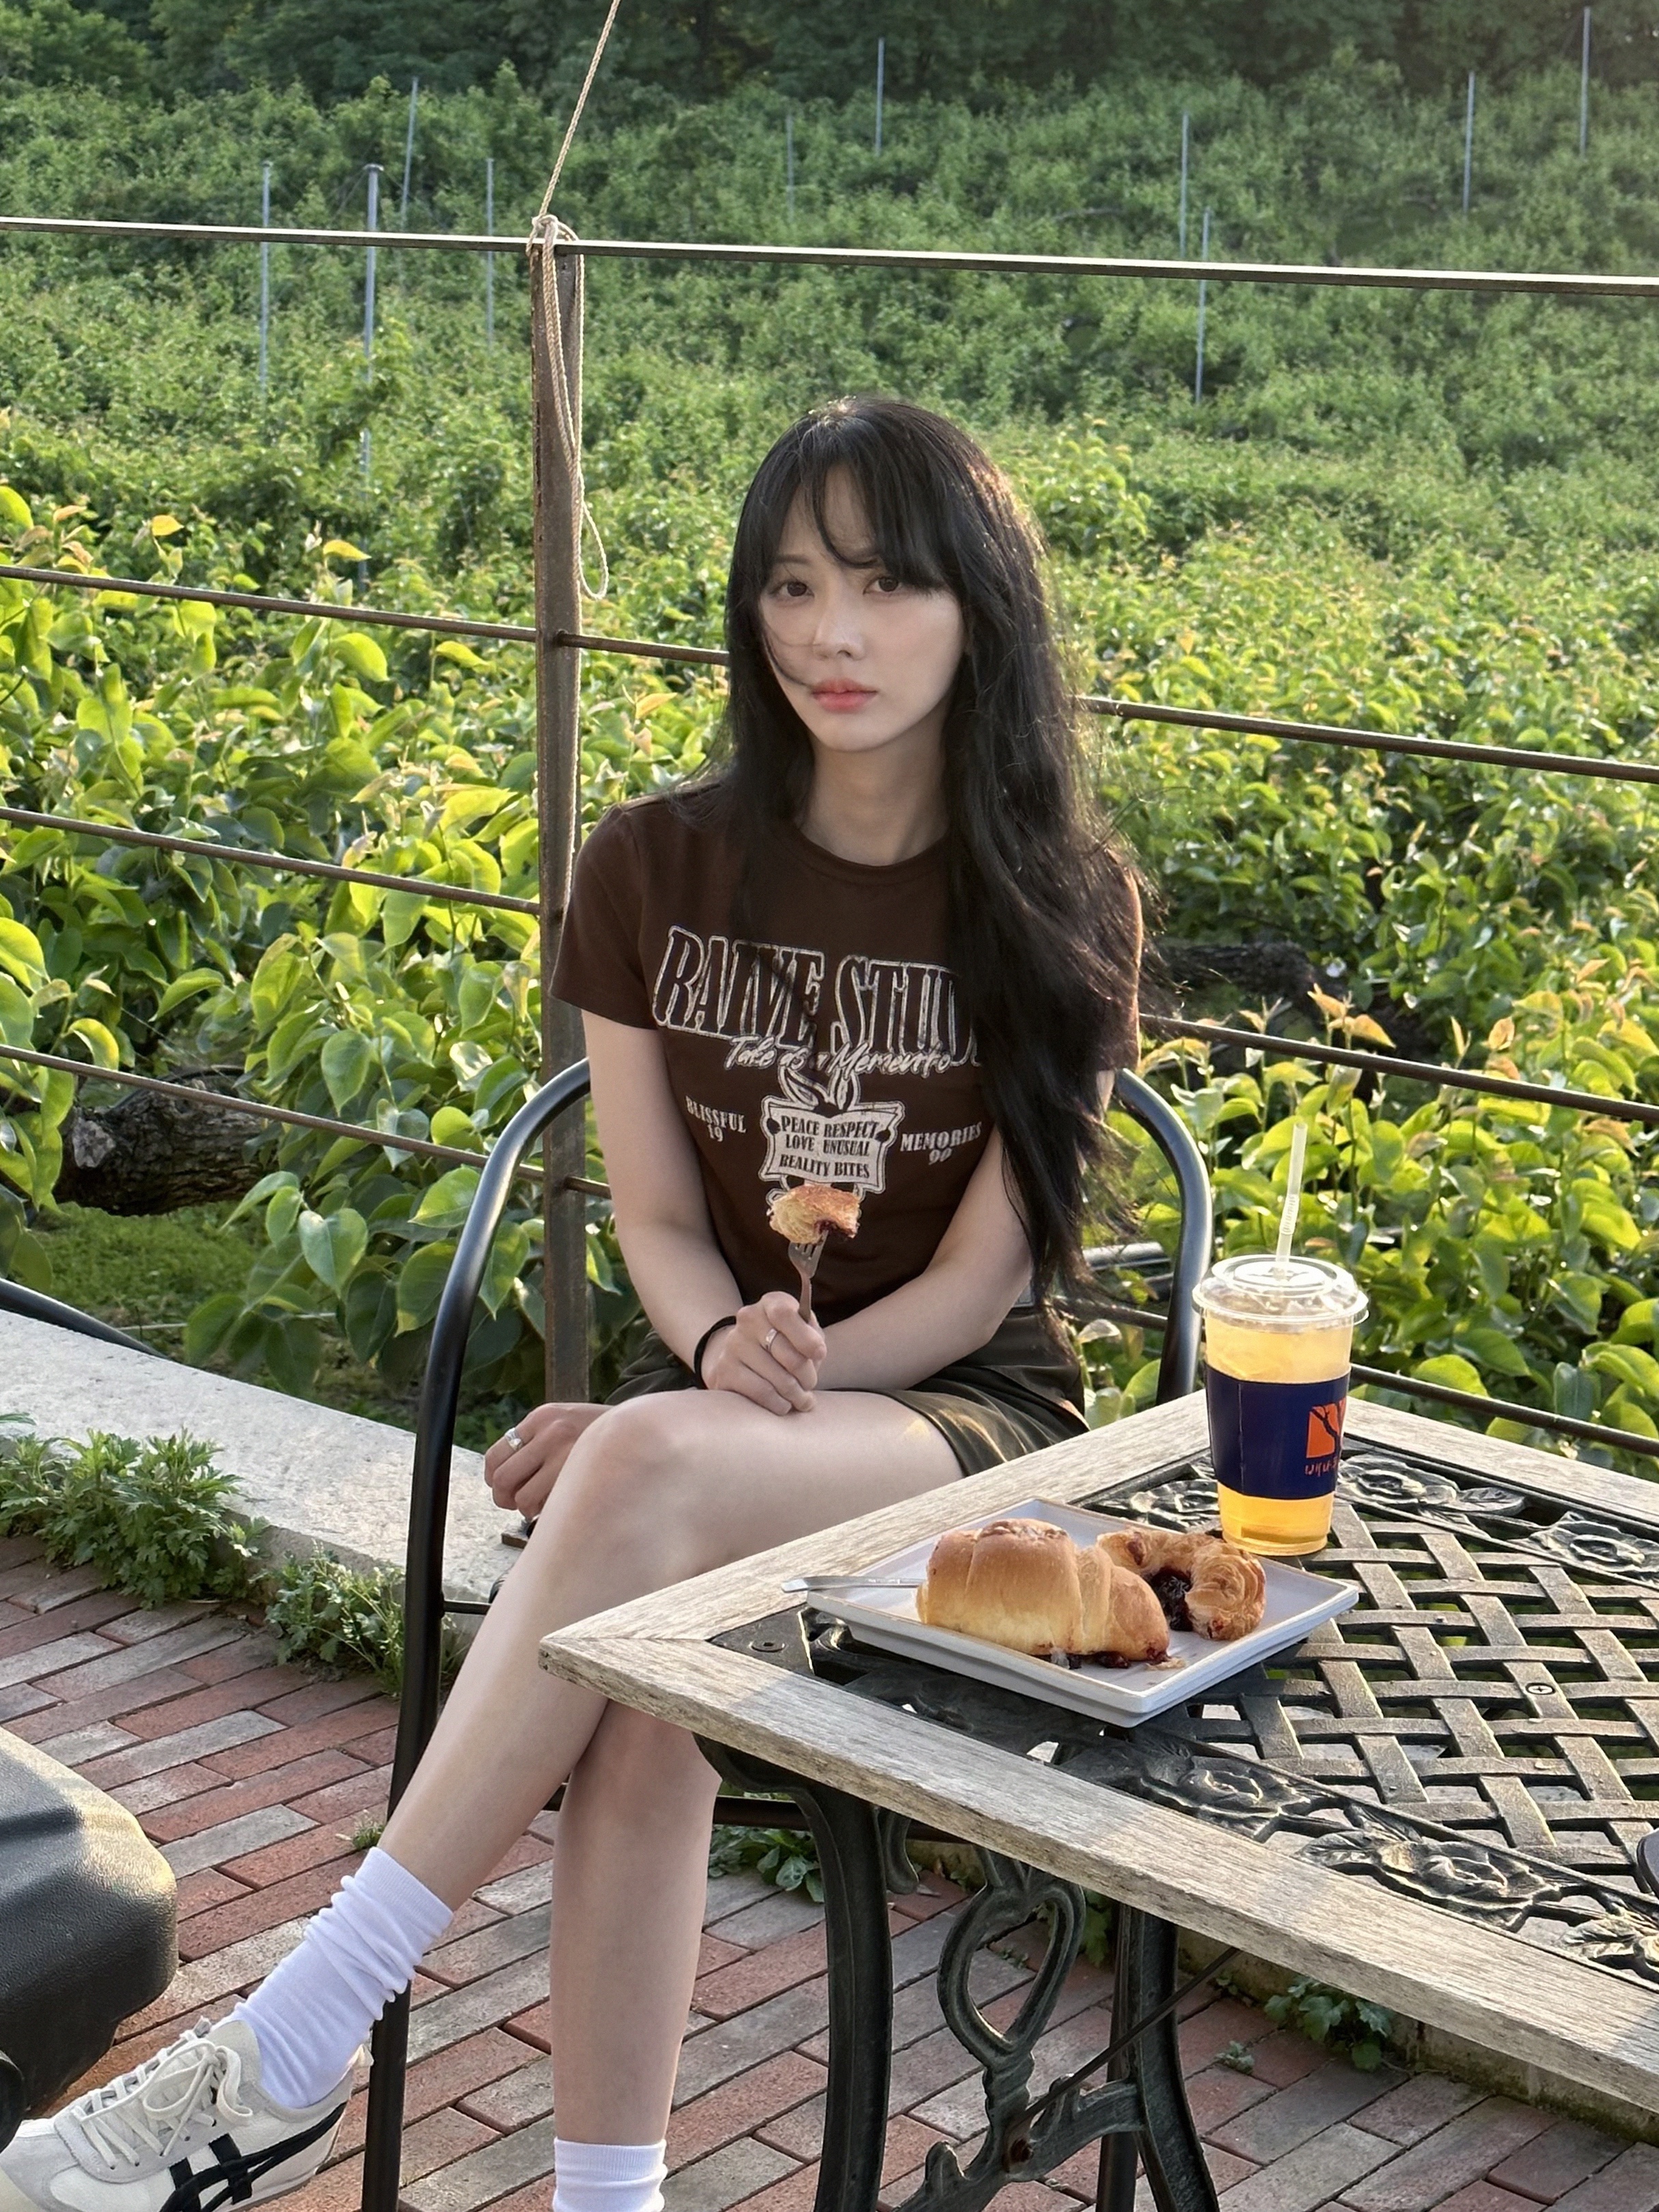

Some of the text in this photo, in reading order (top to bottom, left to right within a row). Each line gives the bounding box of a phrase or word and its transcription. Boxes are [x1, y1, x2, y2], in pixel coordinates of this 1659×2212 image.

[830, 954, 983, 1067] STUD
[724, 1035, 777, 1071] Take
[778, 1046, 811, 1071] as
[826, 1041, 952, 1079] Memento
[685, 1095, 747, 1133] BLISSFUL
[781, 1115, 879, 1139] PEACE RESPECT
[707, 1124, 724, 1142] 19
[786, 1134, 870, 1156] LOVE UNUSUAL
[900, 1121, 982, 1151] MEMORIES
[780, 1153, 870, 1179] REALITY BITES
[928, 1147, 952, 1165] 90
